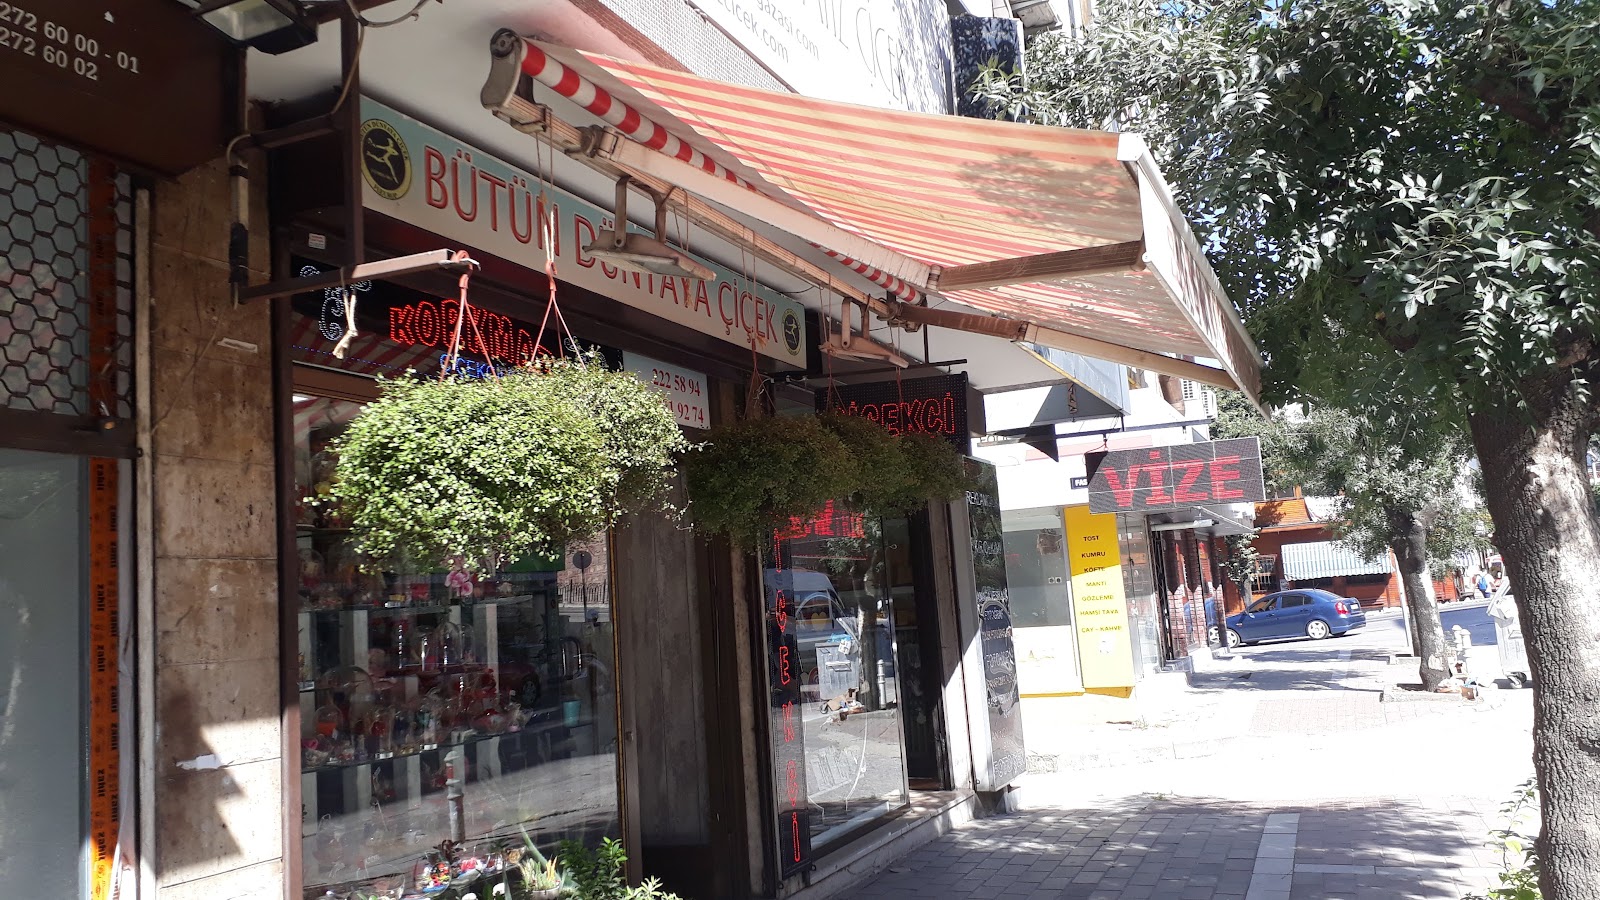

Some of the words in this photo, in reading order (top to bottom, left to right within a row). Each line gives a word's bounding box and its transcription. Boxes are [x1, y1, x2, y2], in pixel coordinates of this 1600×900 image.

[0, 1, 38, 33] 272
[43, 21, 69, 45] 60
[74, 33, 99, 57] 00
[116, 51, 140, 74] 01
[0, 26, 36, 57] 272
[43, 45, 68, 69] 60
[73, 57, 98, 81] 02
[424, 145, 560, 257] BÜTÜN
[717, 278, 778, 344] ÇİÇEK
[390, 299, 553, 374] KORKMA
[652, 368, 671, 389] 222
[674, 374, 686, 393] 58
[688, 378, 701, 397] 94
[677, 402, 690, 421] 92
[692, 406, 704, 424] 74
[1102, 450, 1244, 507] VİZE
[1081, 551, 1106, 559] KUMRU
